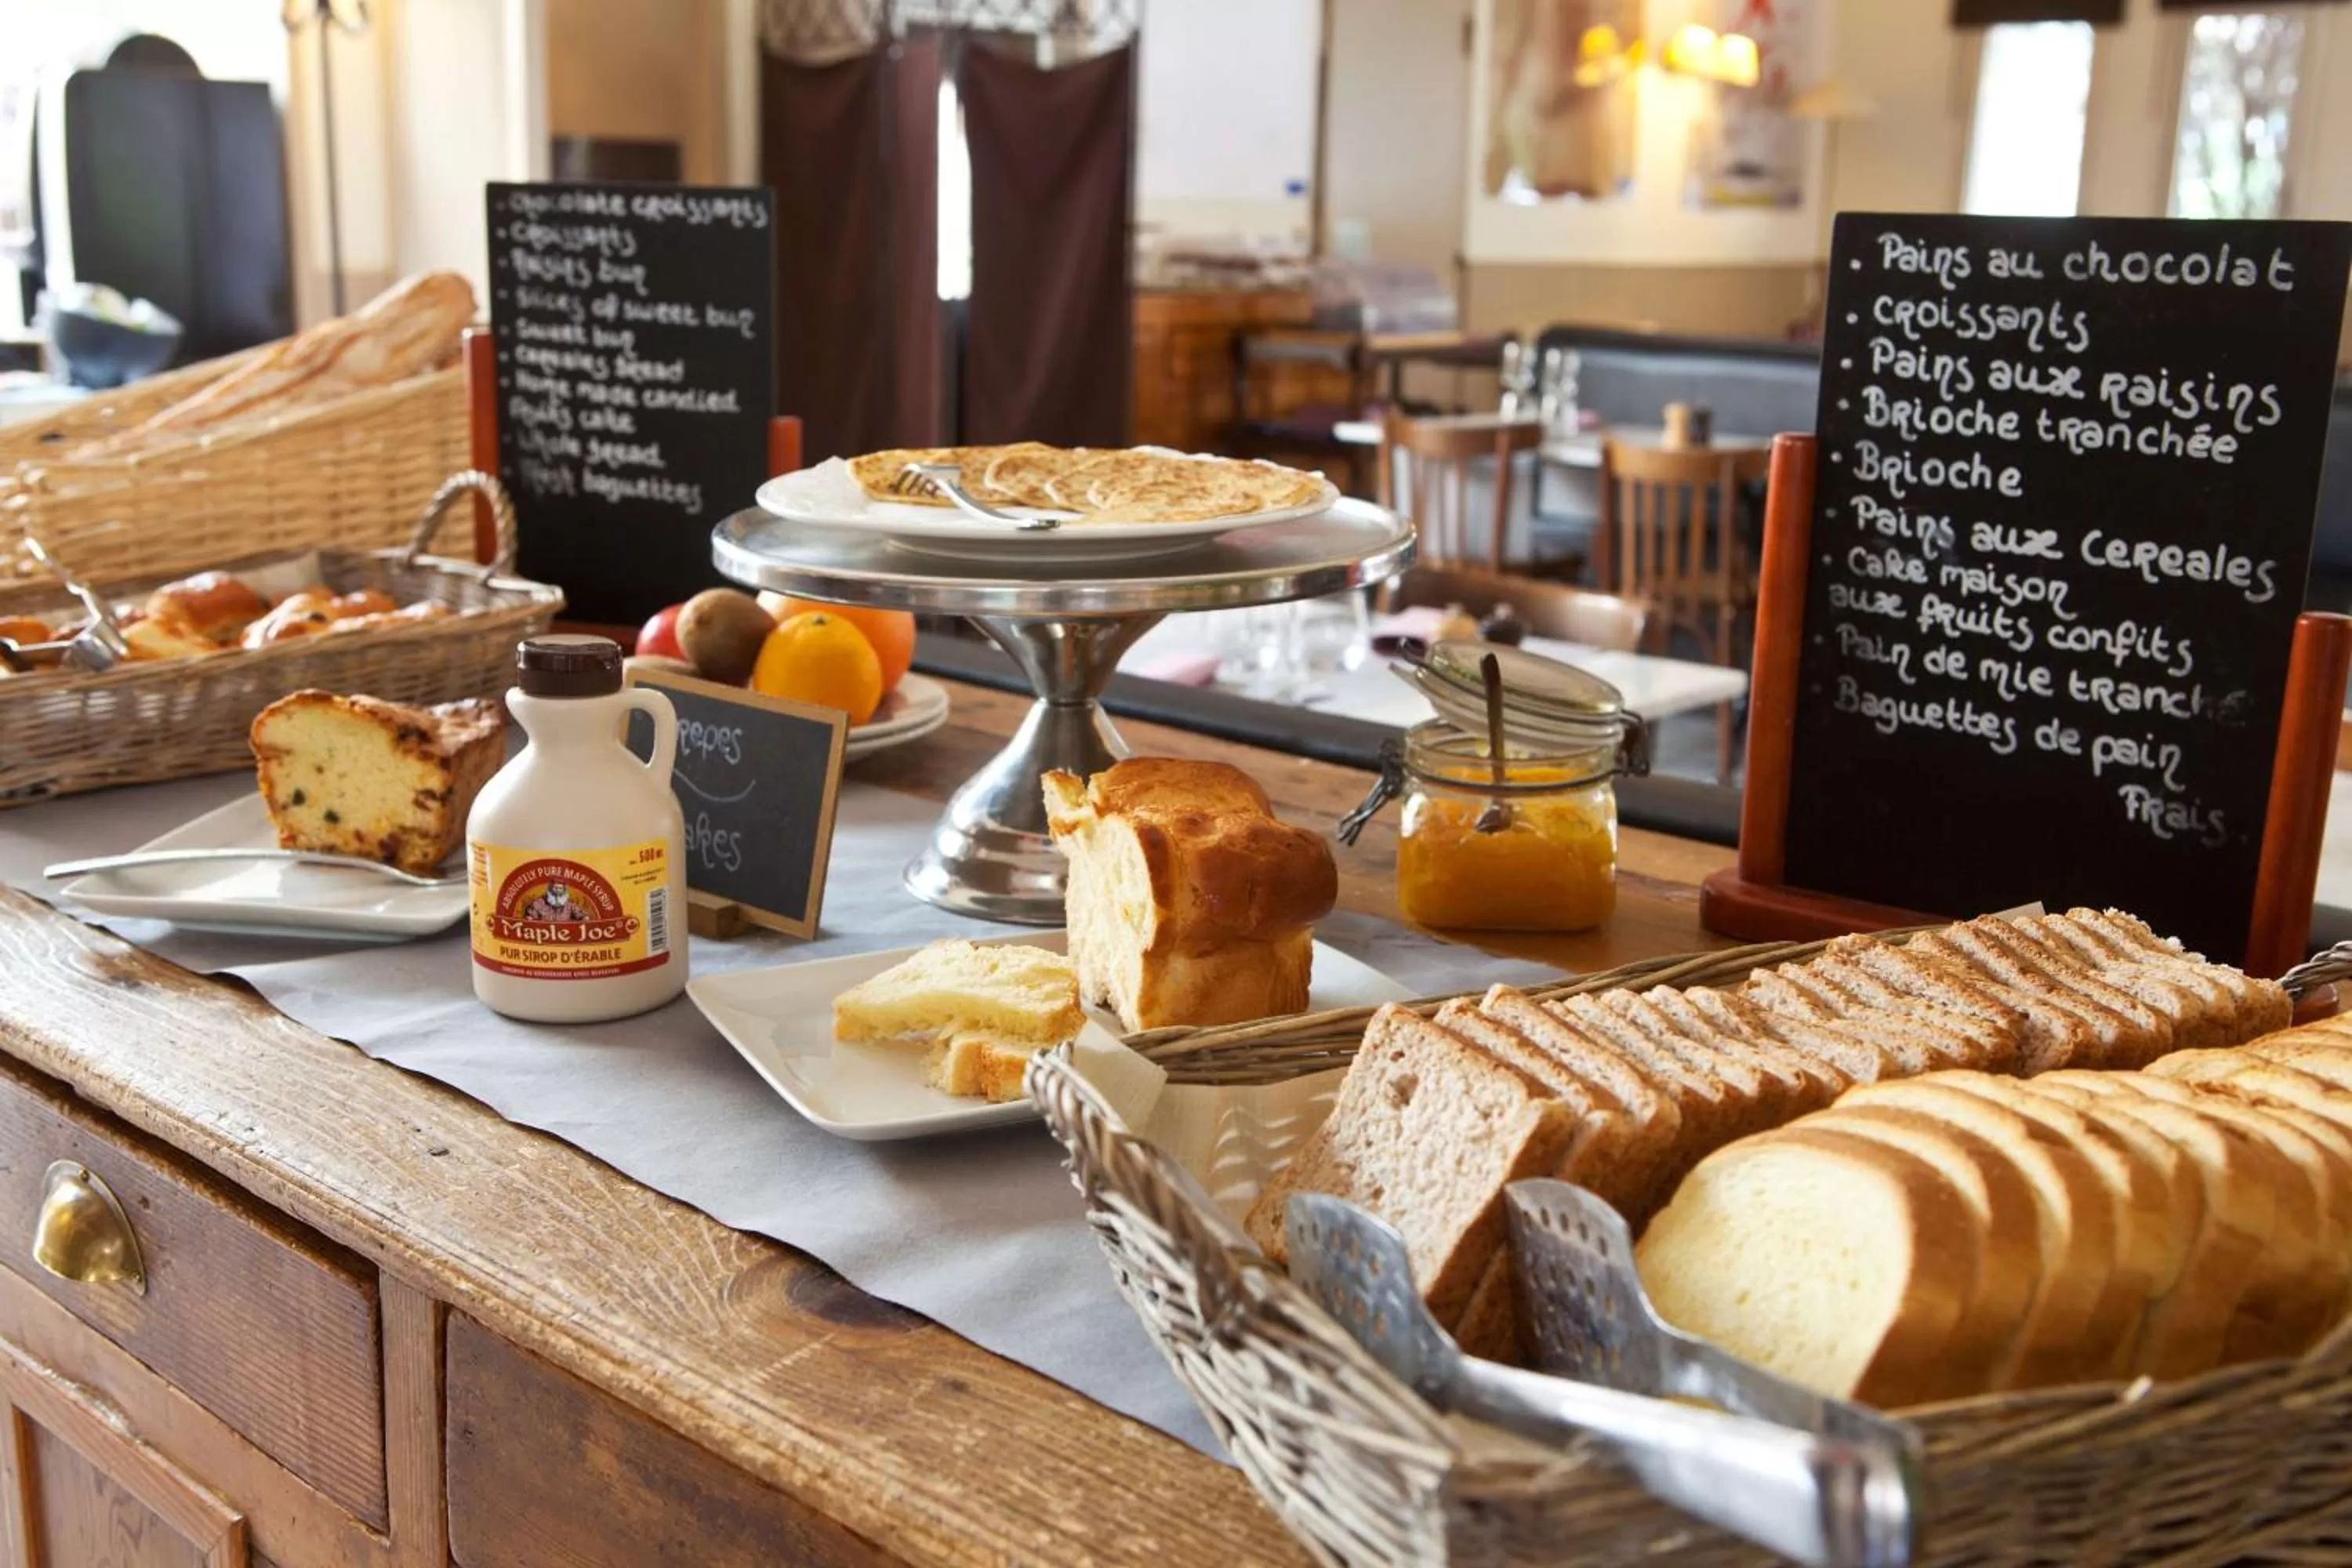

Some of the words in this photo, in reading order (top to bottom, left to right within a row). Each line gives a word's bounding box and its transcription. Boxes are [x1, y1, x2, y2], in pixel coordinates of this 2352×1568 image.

[630, 192, 768, 228] croissants
[597, 258, 650, 296] bun
[1878, 232, 1971, 289] Pains
[1987, 248, 2043, 279] au
[2063, 241, 2294, 292] chocolat
[590, 292, 620, 323] of
[706, 303, 757, 339] bun
[1868, 337, 1975, 401] Pains
[1988, 360, 2085, 399] aux
[1862, 385, 2020, 441] Brioche
[2038, 408, 2239, 464] tranchée
[1853, 439, 2024, 499] Brioche
[1849, 495, 1956, 560] Pains
[1970, 521, 2064, 560] aux
[1847, 546, 1929, 585] Cake
[1940, 562, 2078, 621] maison
[1828, 583, 1907, 619] aux
[1917, 596, 2034, 652] fruits
[2046, 619, 2194, 677] confits
[1834, 623, 1917, 684] Pain
[1923, 644, 1969, 680] de
[1979, 657, 2055, 701] mie
[677, 718, 743, 765] repes
[1833, 674, 2019, 754] Baguettes
[2034, 717, 2082, 756] de
[2091, 731, 2187, 792] pain
[503, 869, 537, 910] ABSOLUTELY
[537, 866, 563, 877] PURE
[564, 869, 595, 889] MAPLE
[591, 883, 615, 911] SYRUP
[499, 946, 521, 960] PUR
[521, 948, 557, 963] SIROP
[561, 946, 622, 964] D'ÉRABLE
[502, 919, 572, 944] Maple
